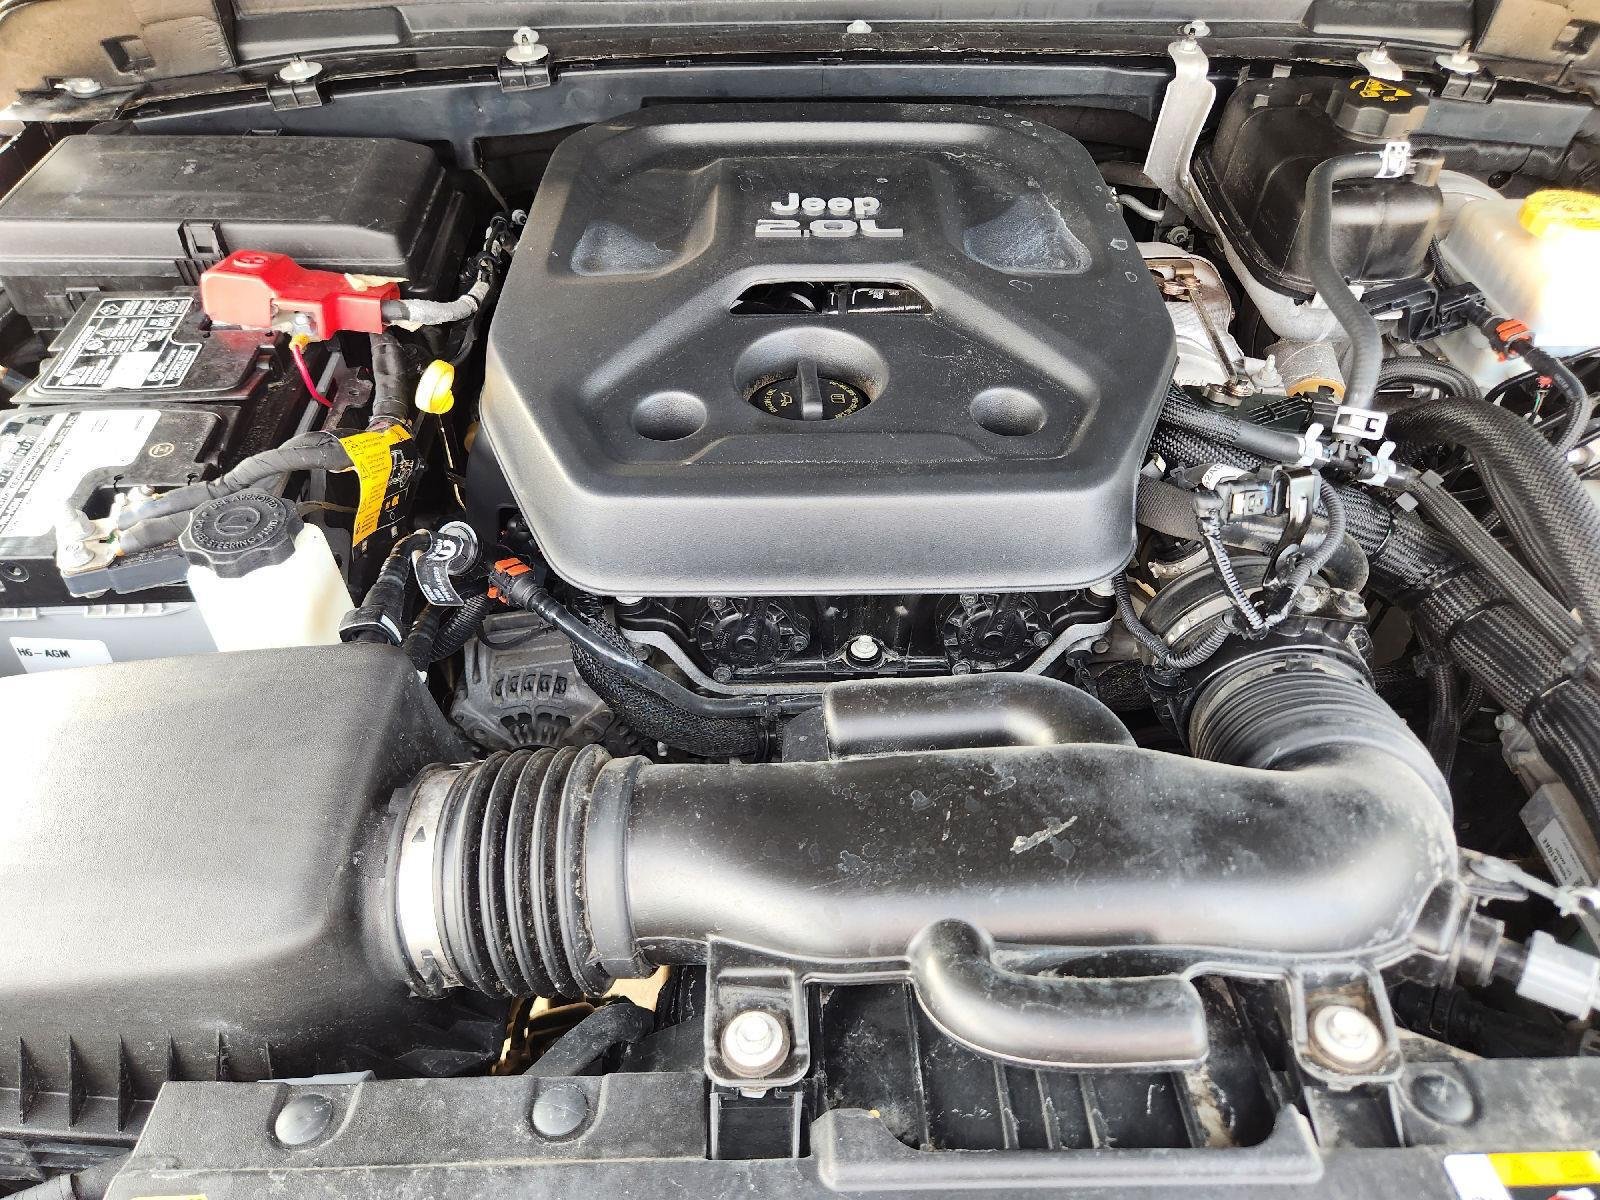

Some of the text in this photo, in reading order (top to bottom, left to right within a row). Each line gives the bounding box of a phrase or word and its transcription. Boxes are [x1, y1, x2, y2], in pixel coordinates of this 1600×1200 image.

[771, 192, 881, 219] Jeep
[755, 219, 904, 238] 2.0L
[209, 493, 278, 510] USE APPROVED
[207, 537, 257, 550] STEERING
